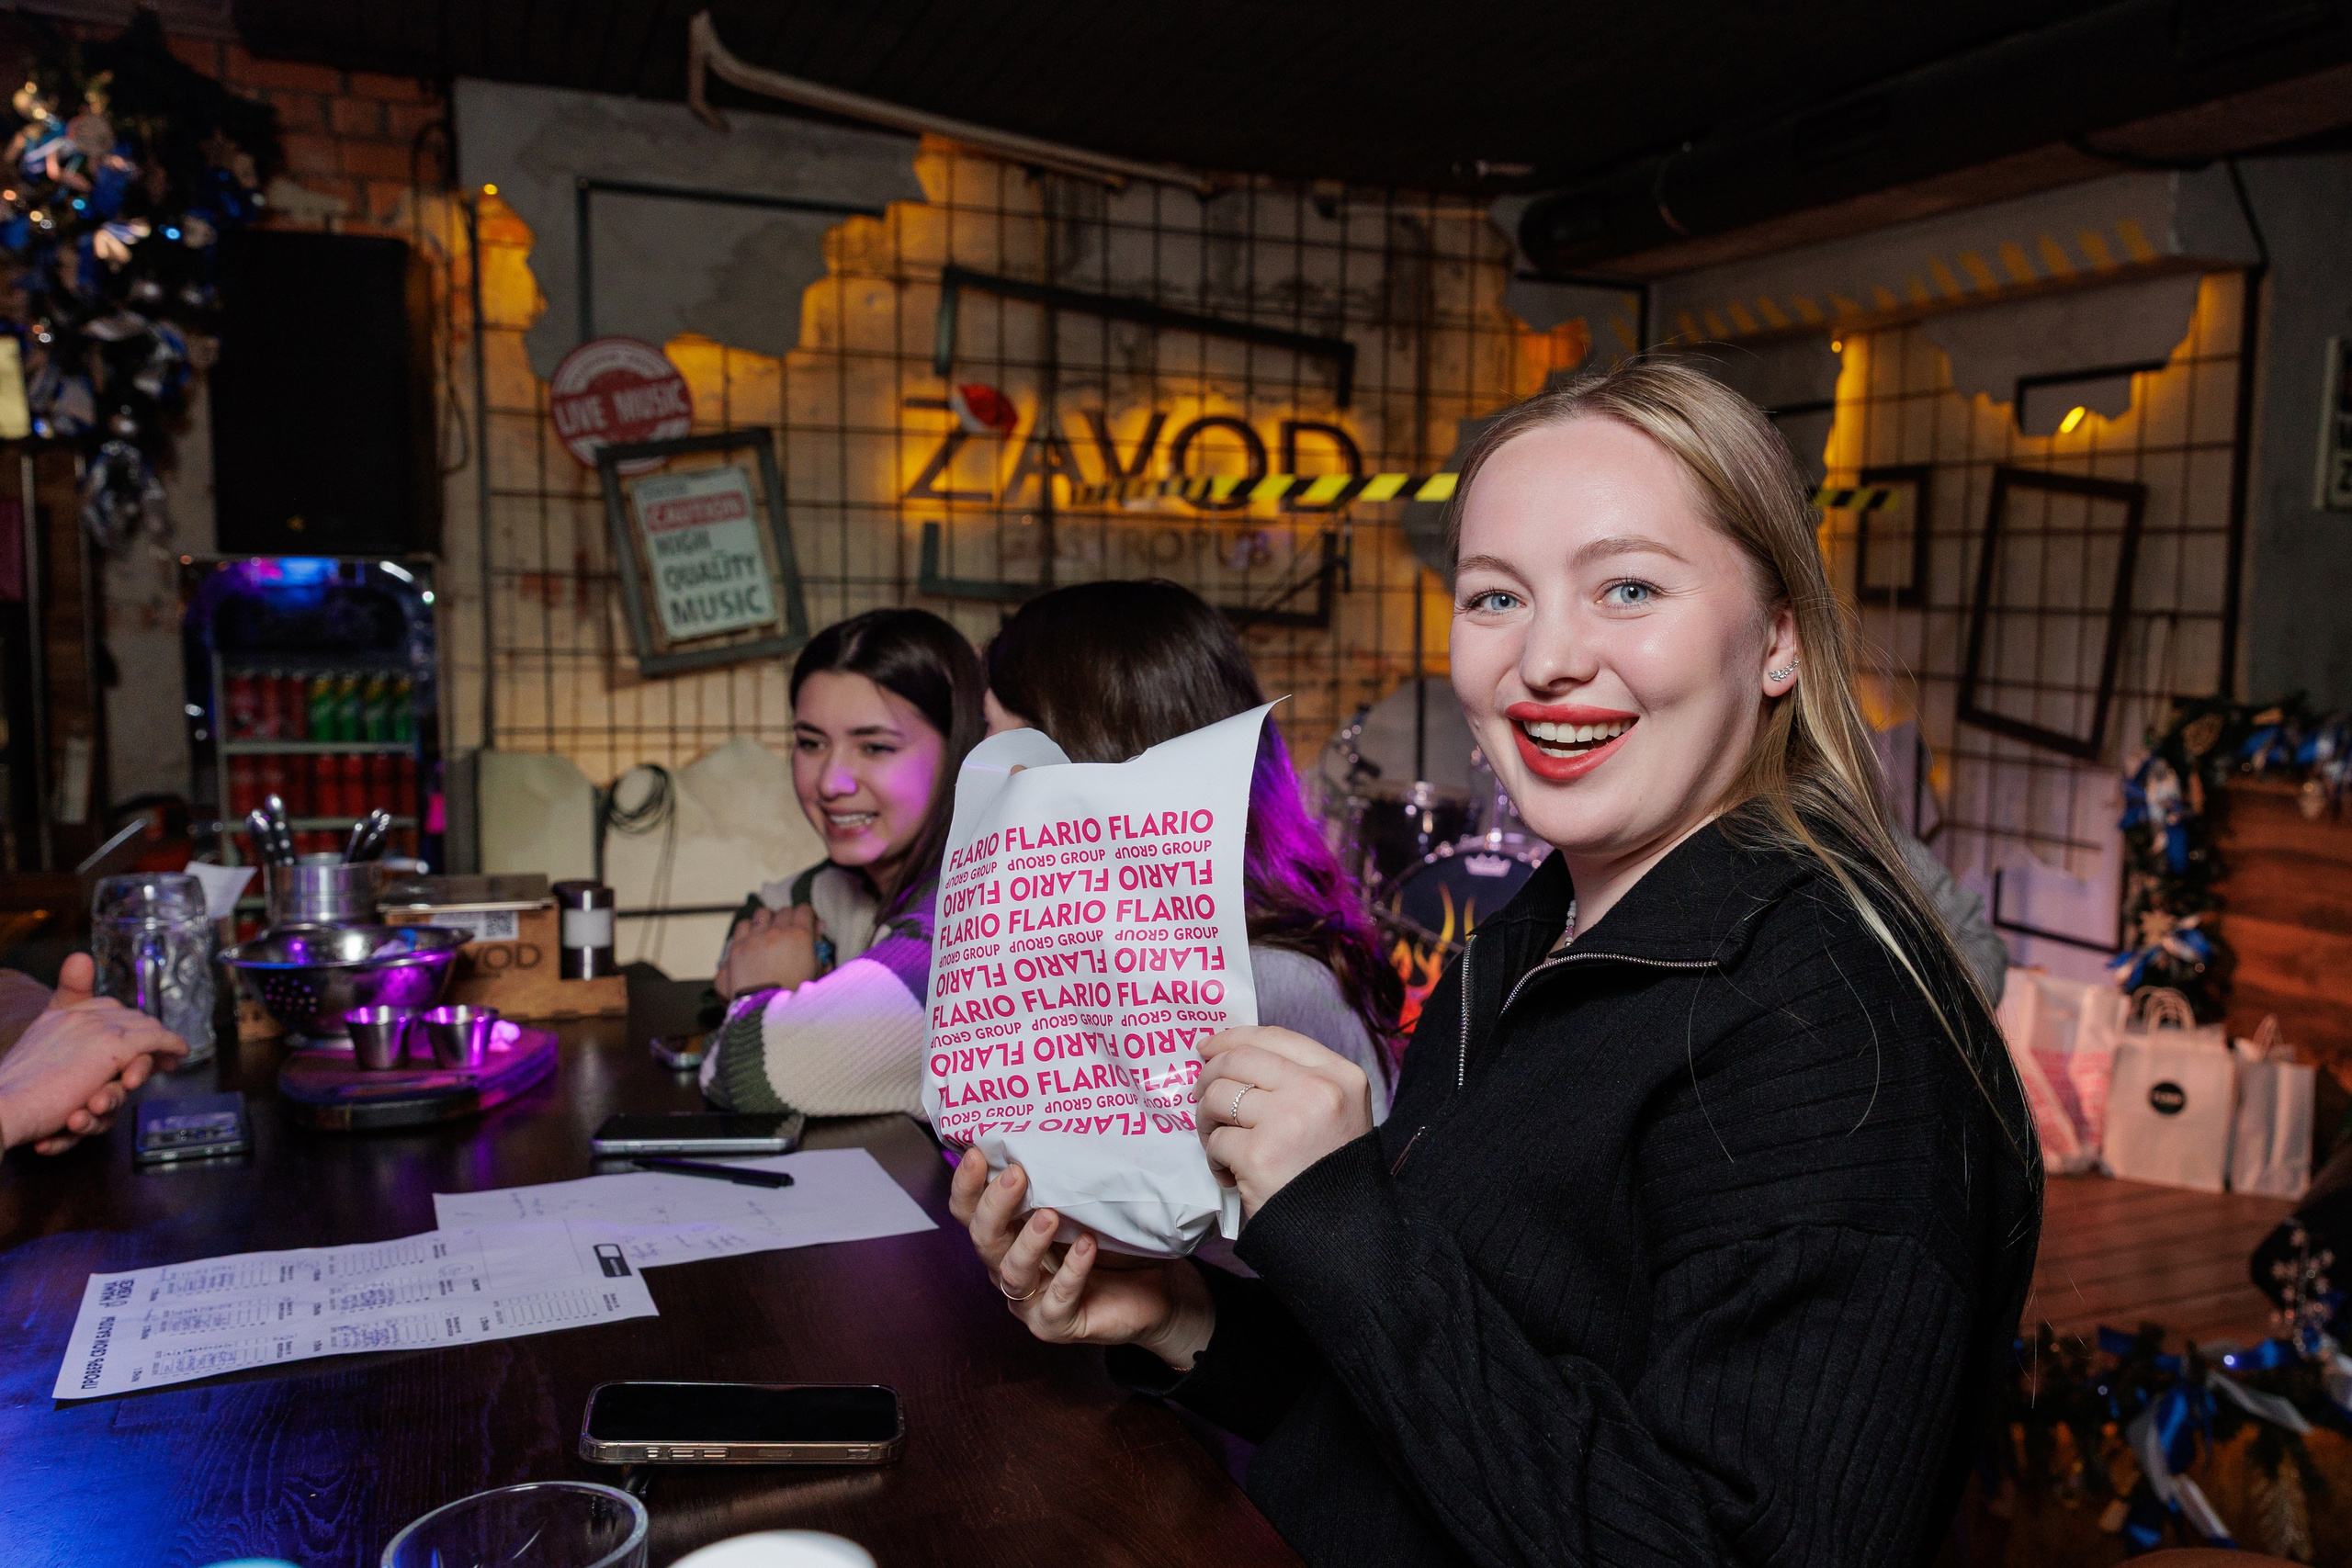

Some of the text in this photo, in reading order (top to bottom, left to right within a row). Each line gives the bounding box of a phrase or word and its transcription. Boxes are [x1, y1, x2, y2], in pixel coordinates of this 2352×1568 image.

[553, 378, 689, 435] LIVE MUSIC
[904, 398, 1362, 513] ZAVOD
[647, 494, 744, 530] CAUTION
[655, 528, 712, 556] HIGH
[663, 553, 756, 592] QUALITY
[670, 584, 763, 626] MUSIC
[949, 808, 1214, 872] FLARIO FLARIO FLARIO
[970, 861, 998, 880] GROUP
[1007, 852, 1056, 871] GROUP
[1060, 849, 1106, 864] GROUP
[1114, 843, 1158, 860] GROUP
[1162, 840, 1212, 855] GROUP
[944, 859, 1213, 918] FLARIO FLARIO FLARIO
[940, 894, 1215, 950] FLARIO FLARIO FLARIO
[963, 943, 1001, 961] GROUP
[1009, 935, 1054, 954] GROUP
[1057, 930, 1103, 947] GROUP
[1114, 928, 1169, 942] GROUP
[1173, 926, 1218, 942] GROUP
[936, 946, 1225, 998] FLARIO FLARIO FLARIO
[932, 979, 1225, 1030] FLARIO FLARIO FLARIO
[975, 1021, 1022, 1040] GROUP
[1031, 1013, 1078, 1032] GROUP
[1080, 1013, 1114, 1027] GROUP
[1121, 1010, 1171, 1026] GROUP
[1176, 1010, 1227, 1021] GROUP
[931, 1027, 1229, 1077] FLARIO FLARIO LARIO
[938, 1060, 1208, 1111] FLARIO FLARIO FLAR
[939, 1110, 981, 1129] GROU
[986, 1103, 1034, 1118] GROUP
[1045, 1098, 1091, 1114] GROUP
[1096, 1093, 1138, 1109] GROUP
[1039, 1111, 1147, 1135] FLARIO
[81, 1358, 104, 1390] ПРОВЕРЬ
[96, 1315, 115, 1338] БАЛЛЫ
